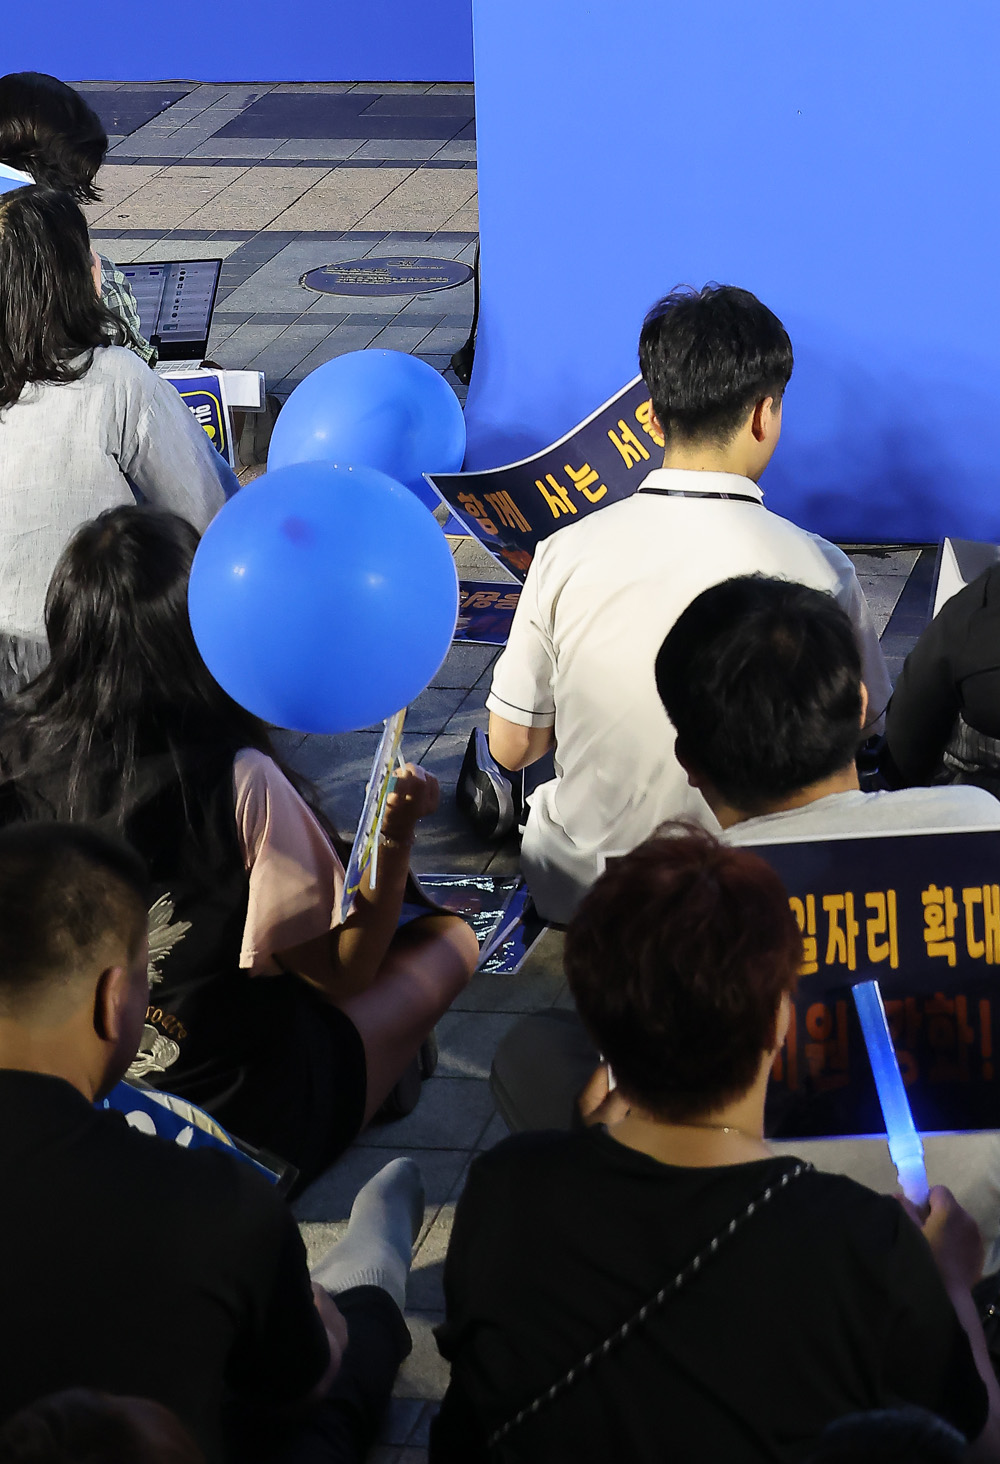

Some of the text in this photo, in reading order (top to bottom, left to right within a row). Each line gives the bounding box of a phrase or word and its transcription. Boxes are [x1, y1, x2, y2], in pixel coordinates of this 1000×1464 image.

[457, 490, 532, 535] 함께
[534, 462, 608, 519] 사는
[788, 889, 899, 976] 일자리
